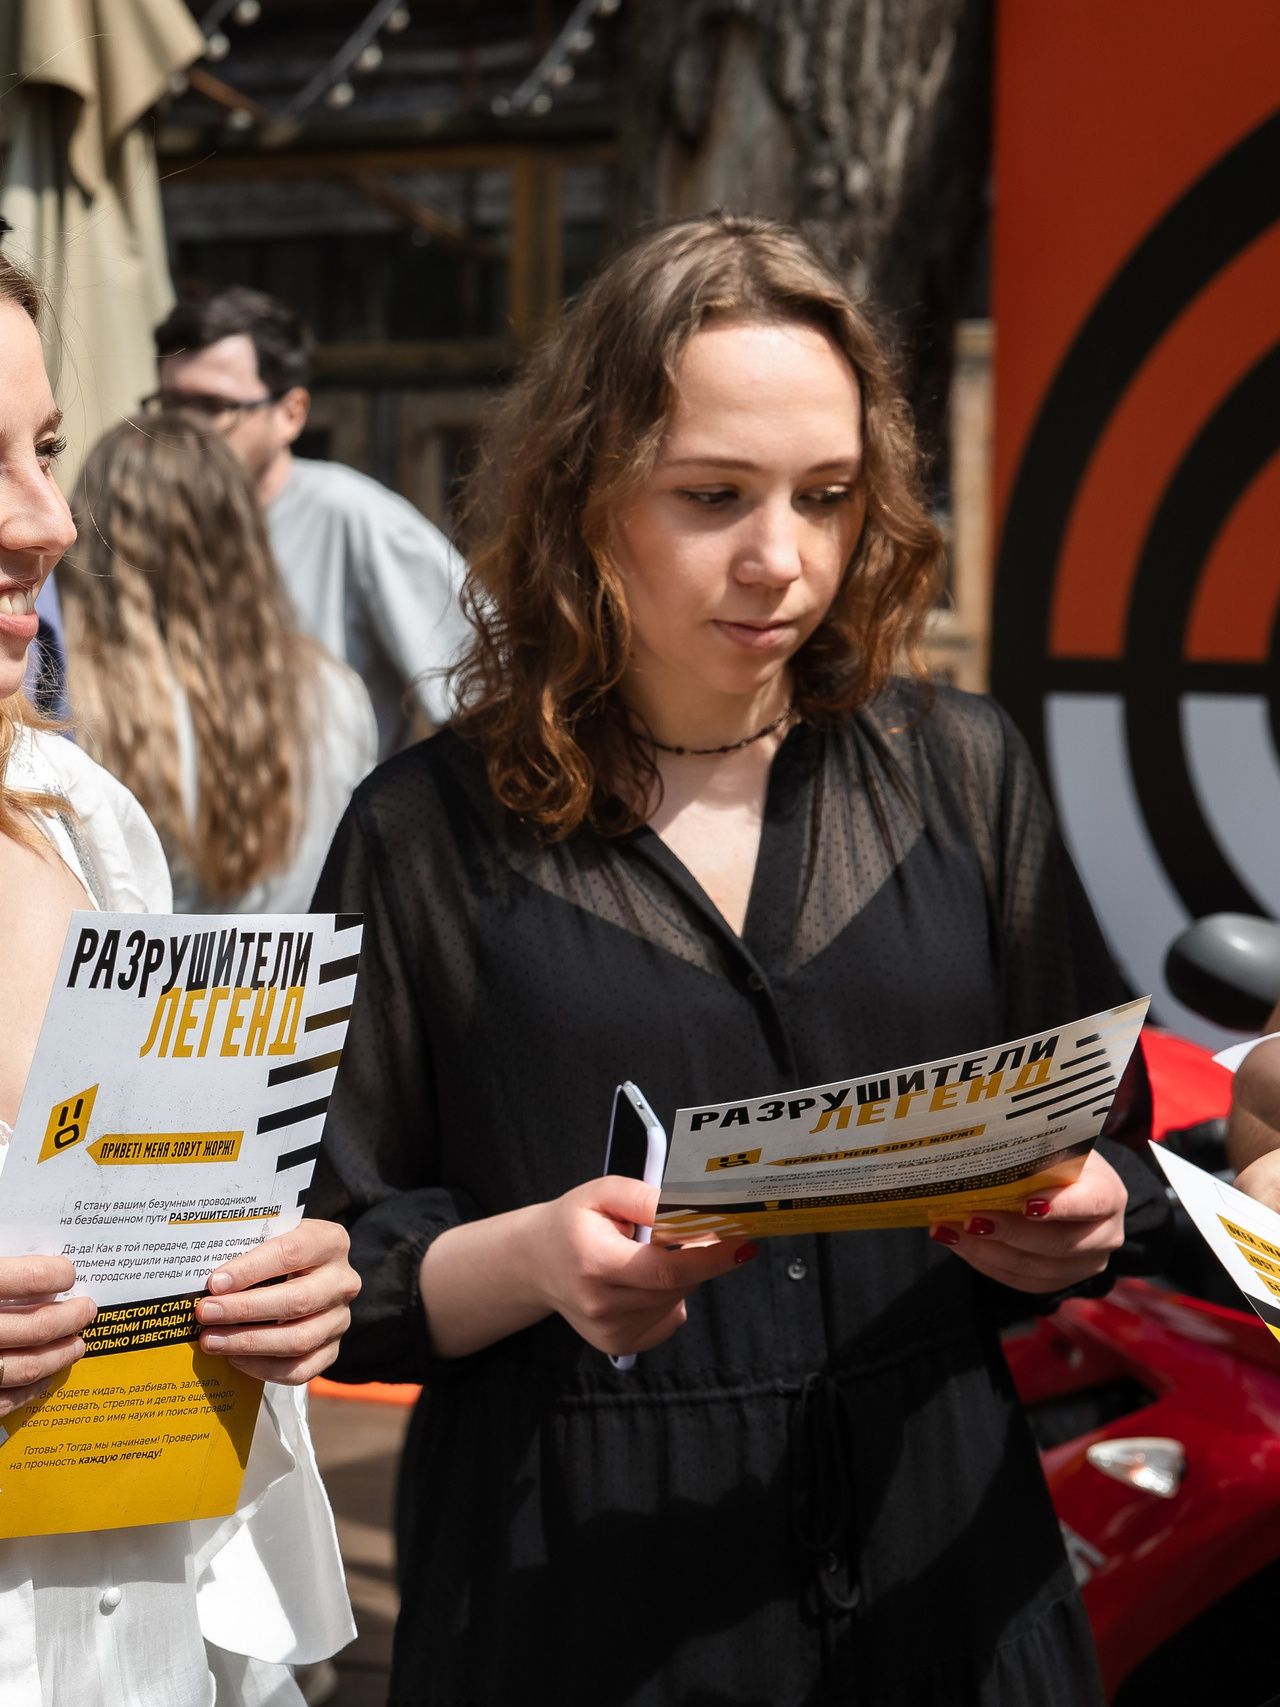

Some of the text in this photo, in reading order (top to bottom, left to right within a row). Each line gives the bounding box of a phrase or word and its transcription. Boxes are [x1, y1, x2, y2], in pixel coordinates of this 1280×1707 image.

[66, 927, 314, 998] РАЗРУШИТЕЛИ
[139, 985, 306, 1059] ЛЕГЕНД
[690, 1034, 1060, 1132] РАЗРУШИТЕЛИ
[809, 1056, 1052, 1135] ЛЕГЕНД
[100, 1139, 236, 1159] ПРИВЕТ! МЕНЯ ЗОВУТ ЖОРЖ!
[784, 1129, 975, 1166] ПРИВЕТ! МЕНЯ ЗОВУТ ЖОРЖ!
[897, 1142, 1009, 1169] РАЗРУШИТЕЛЕЙ
[60, 1204, 282, 1226] на безбашенном пути РАЗРУШИТЕЛЕЙ ЛЕГЕНД!
[74, 1195, 257, 1212] Я стану вашим безумным проводником
[61, 1236, 266, 1256] Да-да! Как в той передаче, где два солидных
[118, 1256, 161, 1268] крушили
[163, 1255, 202, 1265] направо
[90, 1271, 142, 1283] городские
[143, 1269, 183, 1280] легенды
[185, 1268, 191, 1276] и
[97, 1304, 160, 1323] ПРЕДСТОИТ
[161, 1299, 192, 1314] СТАТЬ
[142, 1313, 186, 1330] ПРАВДЫ
[86, 1336, 130, 1352] КОЛЬКО
[131, 1325, 193, 1345] ИЗВЕСТНЫХ
[56, 1387, 90, 1399] будете
[92, 1385, 126, 1398] кидать,
[128, 1381, 177, 1395] разбивать,
[180, 1378, 221, 1389] залезать,
[21, 1418, 49, 1428] всего
[51, 1416, 91, 1428] разного
[93, 1414, 105, 1423] во
[106, 1413, 126, 1422] имя
[128, 1411, 155, 1422] науки
[165, 1406, 198, 1417] поиска
[200, 1401, 236, 1416] правды!
[25, 1401, 100, 1416] прискотчевать,
[103, 1397, 144, 1410] стрелять
[154, 1394, 185, 1406] делать
[208, 1389, 235, 1400] много
[24, 1432, 210, 1456] Готовы? Тогда мы начинаем! Проверим
[10, 1448, 163, 1471] на прочность каждую легенду!
